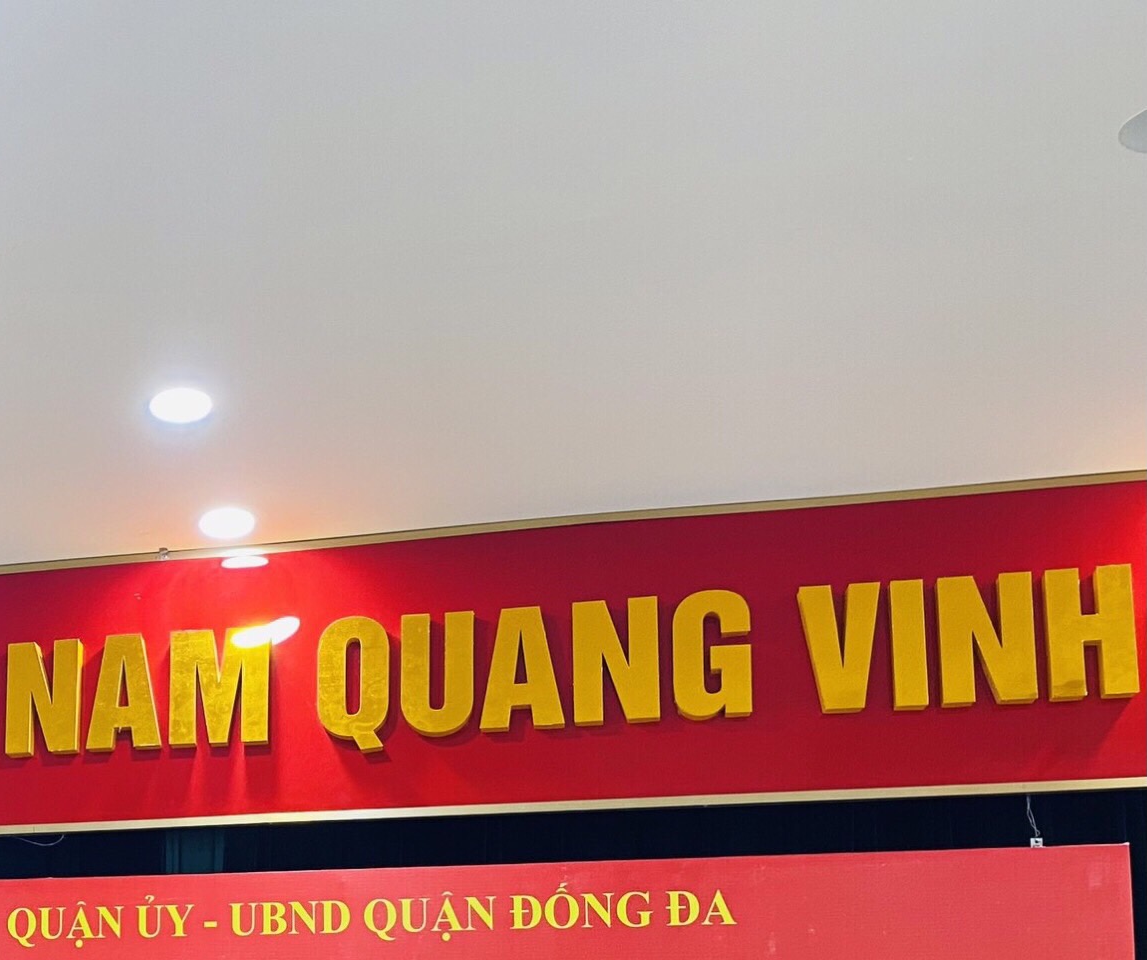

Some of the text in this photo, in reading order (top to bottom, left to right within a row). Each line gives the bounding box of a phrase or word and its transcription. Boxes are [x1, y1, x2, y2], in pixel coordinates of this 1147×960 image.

[6, 622, 272, 755] NAM
[318, 591, 752, 750] QUANG
[798, 565, 1139, 711] VINH
[7, 900, 124, 948] QUẬN
[137, 895, 195, 938] ỦY
[230, 899, 352, 937] UBND
[363, 890, 497, 943] QUẬN
[510, 881, 653, 930] ĐỐNG
[665, 889, 737, 927] ĐA
